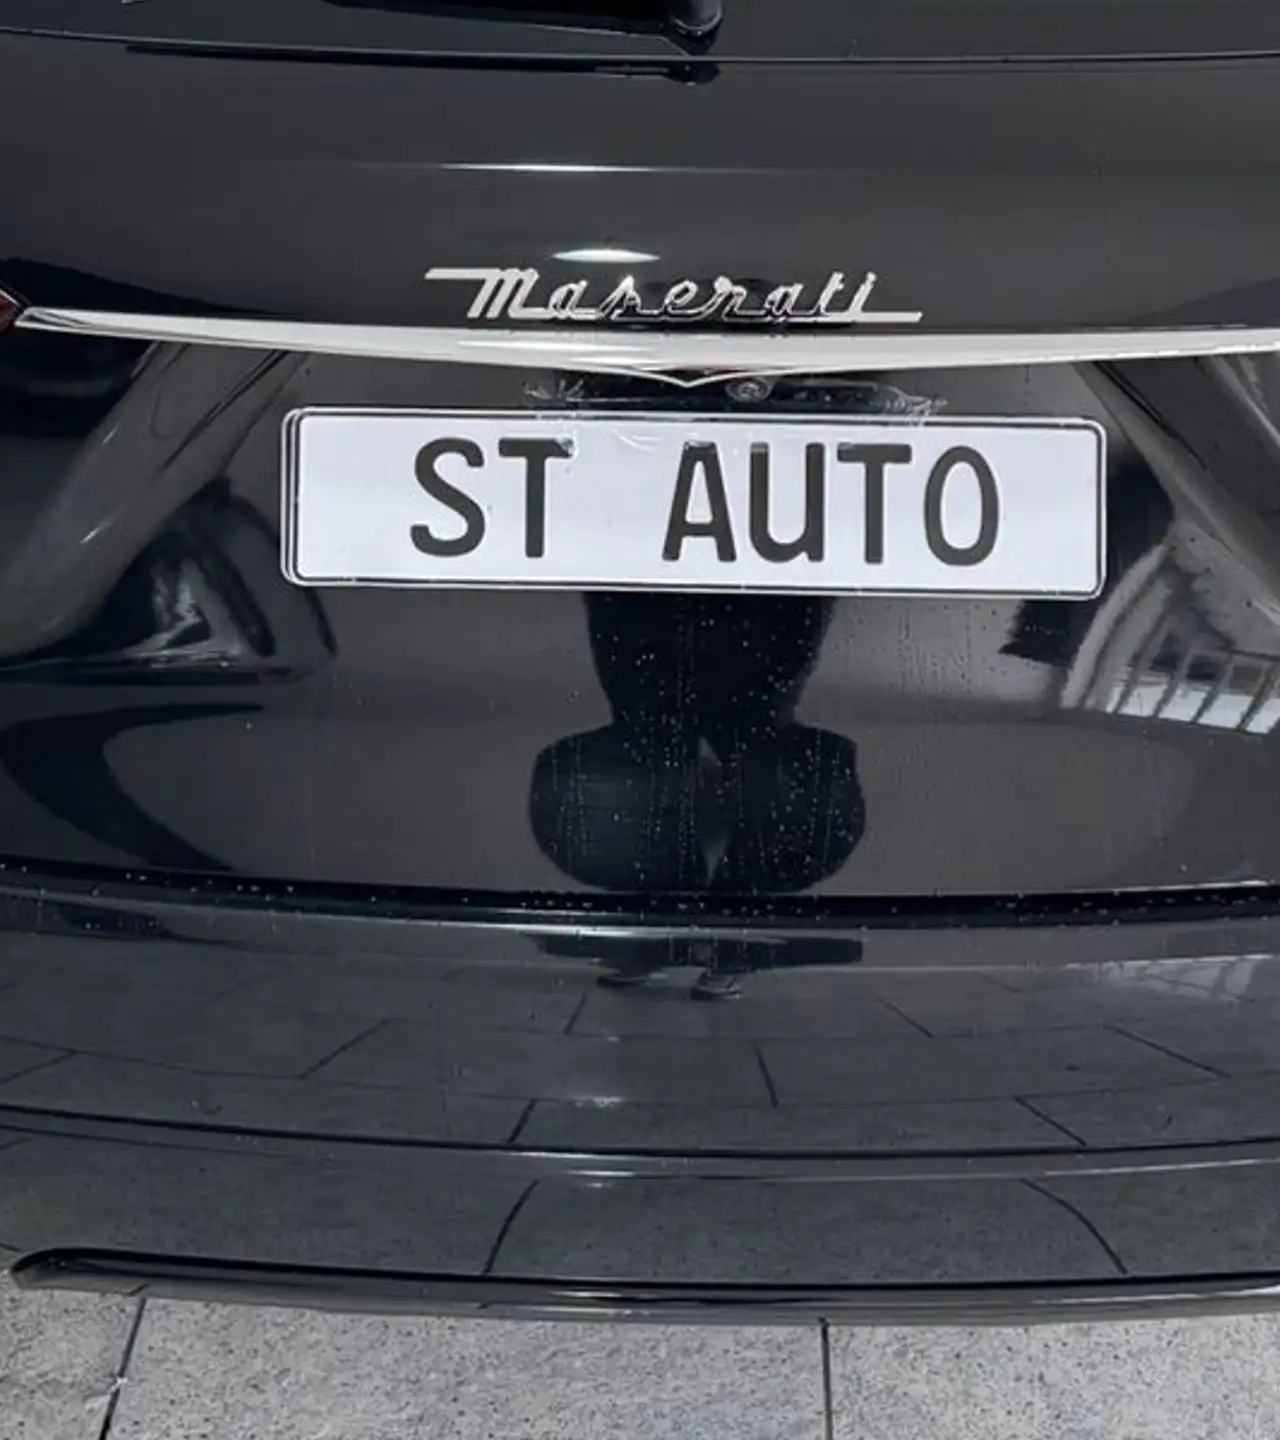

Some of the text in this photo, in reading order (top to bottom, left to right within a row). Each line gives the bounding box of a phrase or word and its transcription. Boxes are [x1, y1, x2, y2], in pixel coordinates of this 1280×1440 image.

[424, 268, 924, 325] Maserati
[409, 437, 1001, 567] ST AUTO
